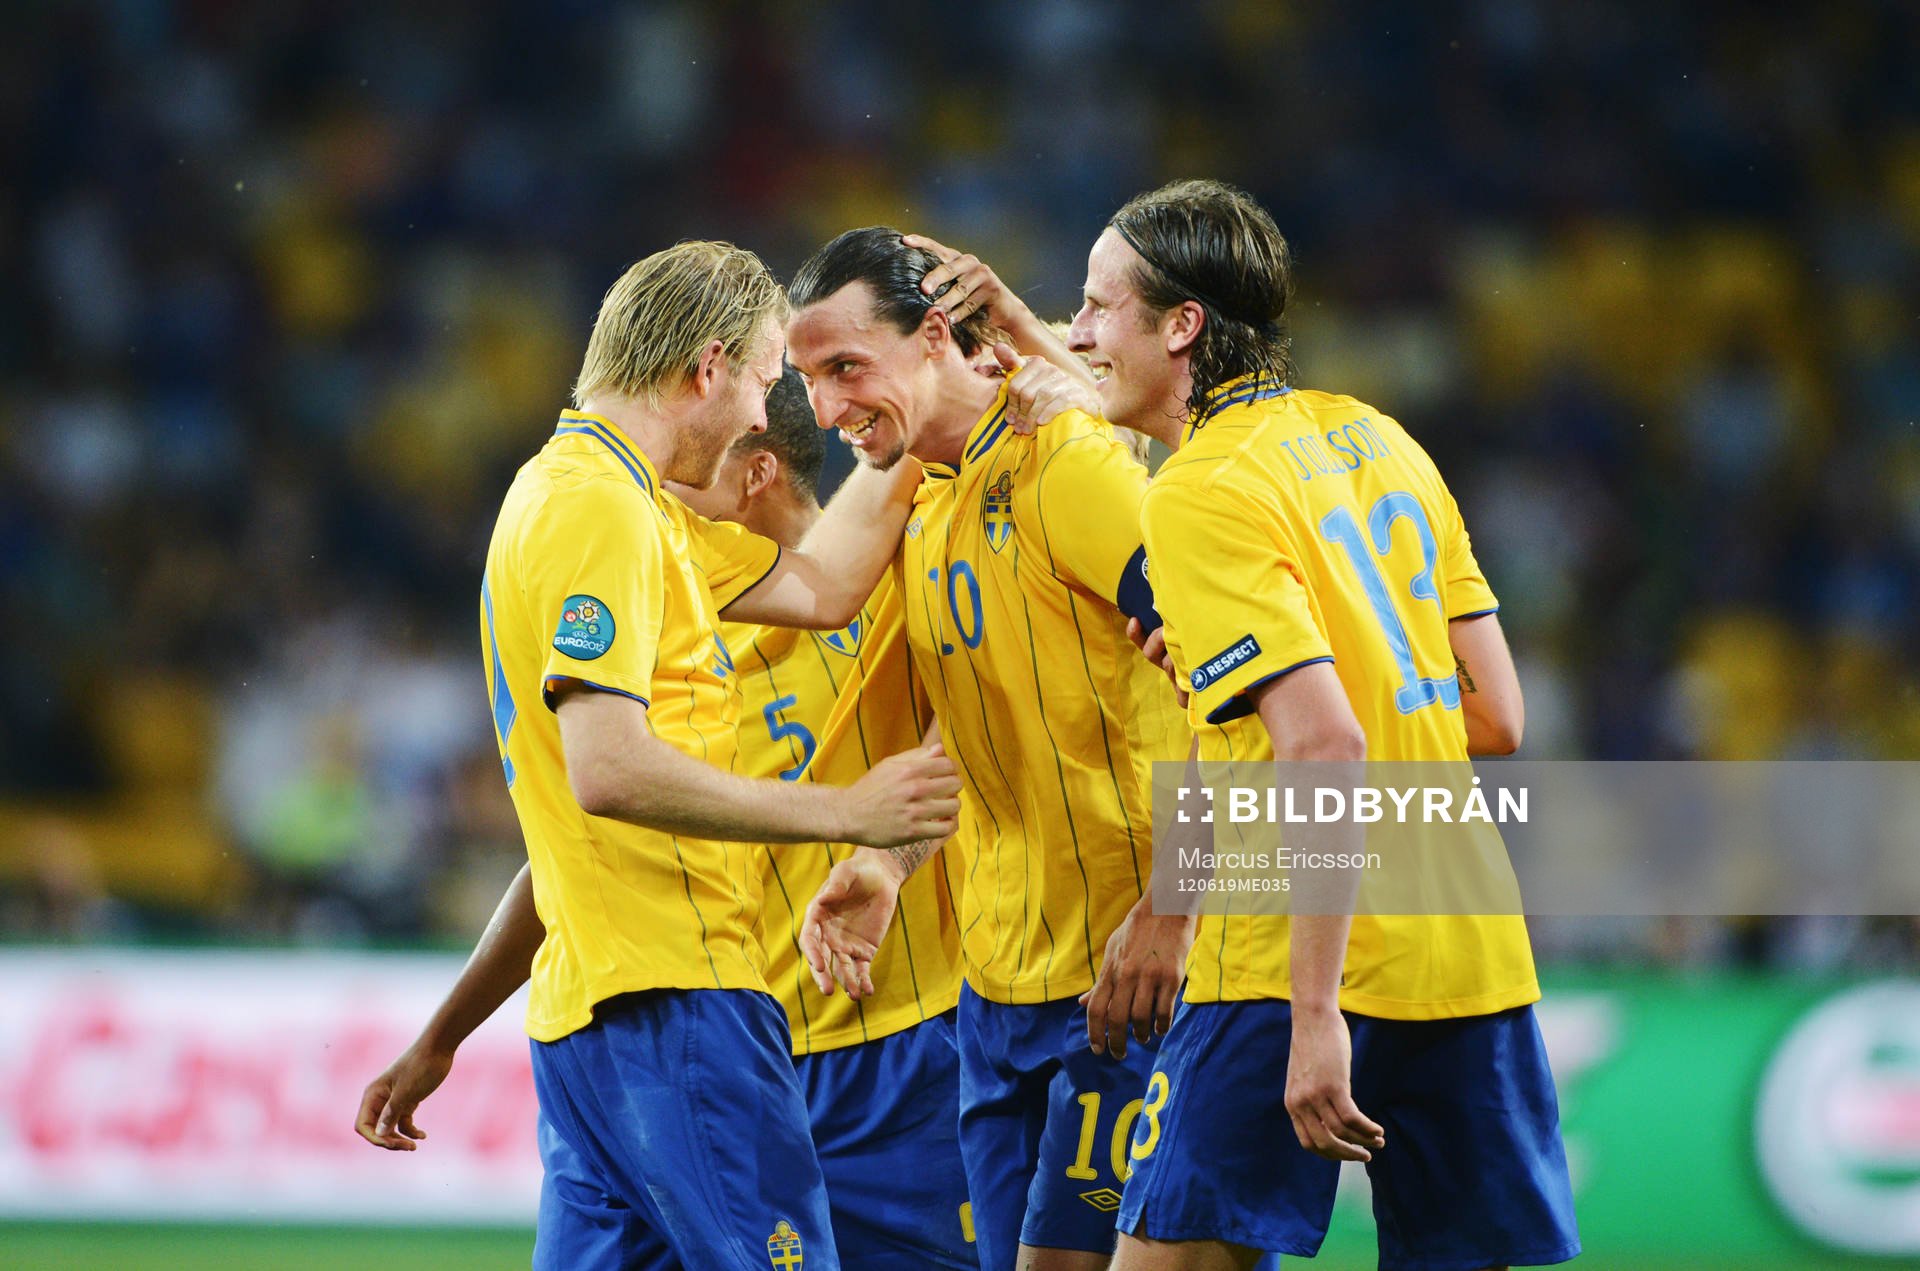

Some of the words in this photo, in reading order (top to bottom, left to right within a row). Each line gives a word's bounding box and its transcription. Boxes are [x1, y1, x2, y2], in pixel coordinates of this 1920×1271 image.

[1319, 491, 1460, 715] 13
[1206, 639, 1256, 677] RESPECT
[763, 694, 816, 781] 5
